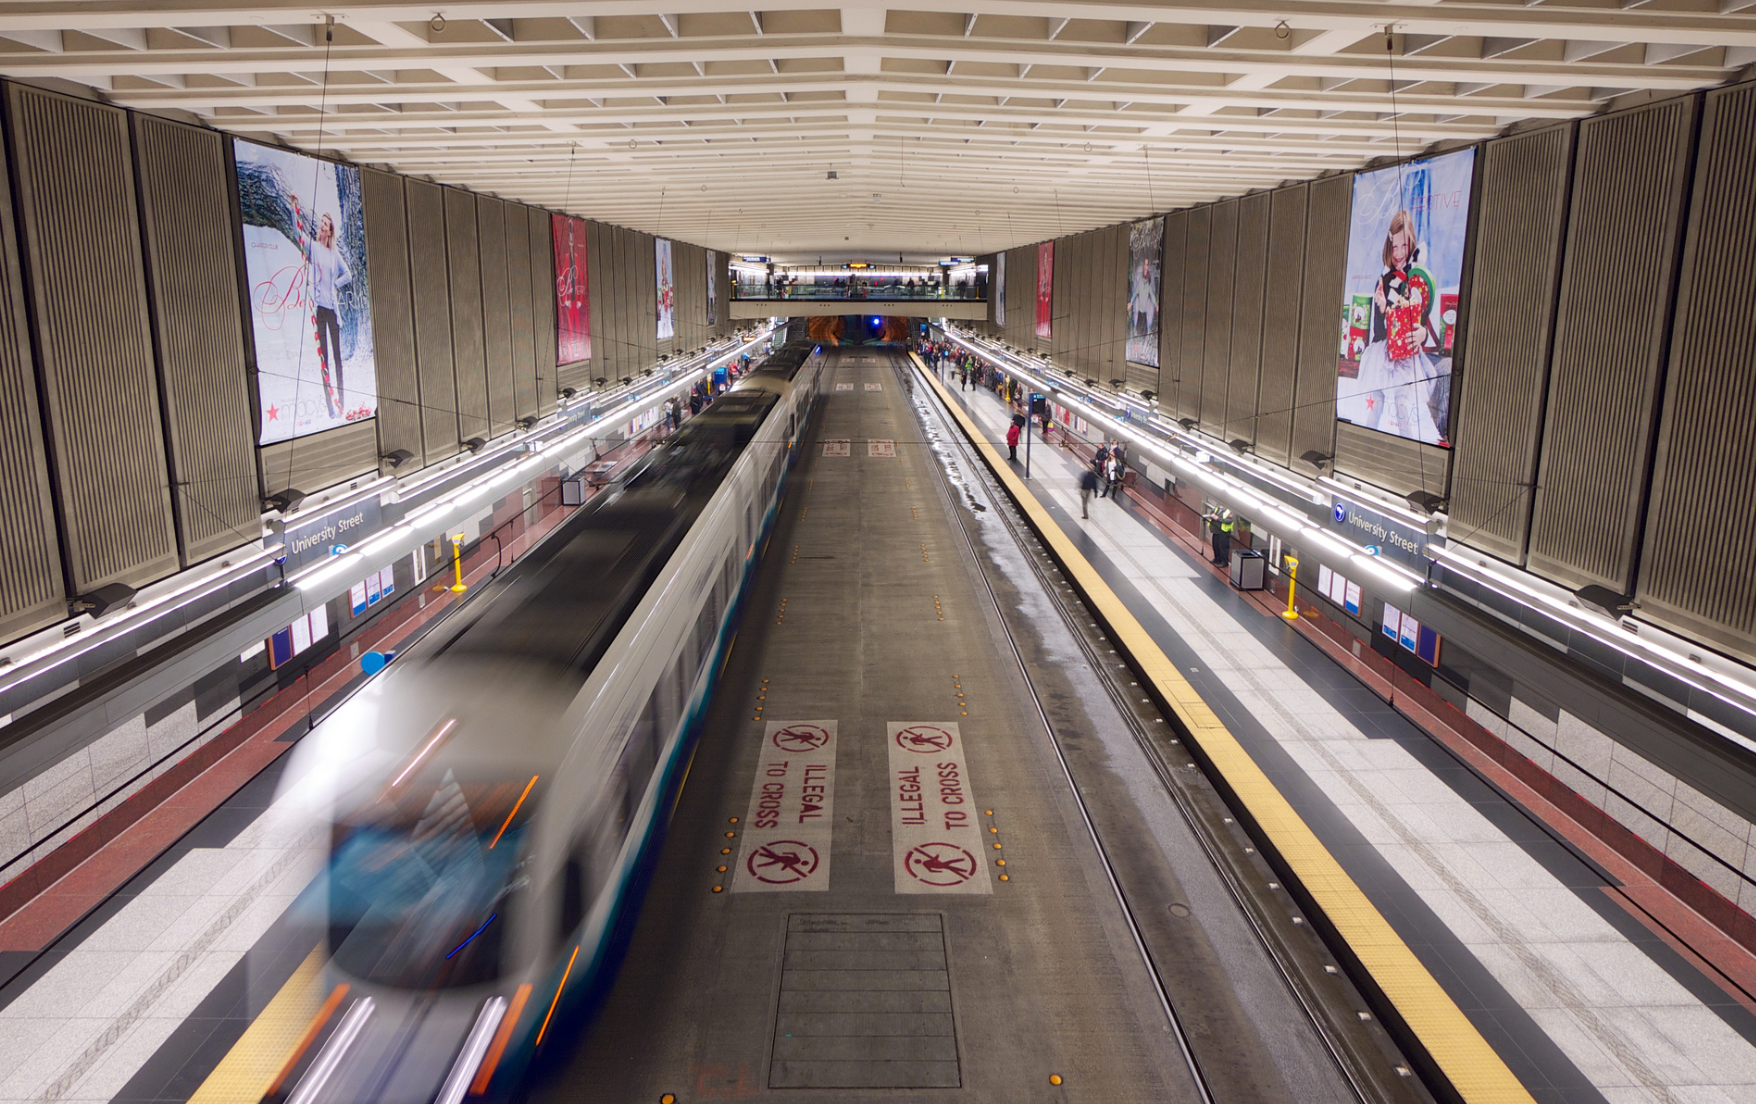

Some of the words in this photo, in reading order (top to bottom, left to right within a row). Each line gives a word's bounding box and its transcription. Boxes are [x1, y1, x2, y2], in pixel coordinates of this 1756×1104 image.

[1411, 190, 1462, 213] FESTIVE
[281, 395, 328, 420] macy's
[291, 526, 336, 554] University
[338, 512, 363, 533] Street
[1348, 511, 1387, 542] University
[1389, 530, 1418, 555] Street
[766, 761, 788, 777] TO
[937, 762, 964, 805] CROSS
[754, 782, 784, 829] CROSS
[798, 764, 827, 824] ILLEGAL
[898, 766, 925, 825] ILLEGAL
[944, 811, 969, 830] TO
